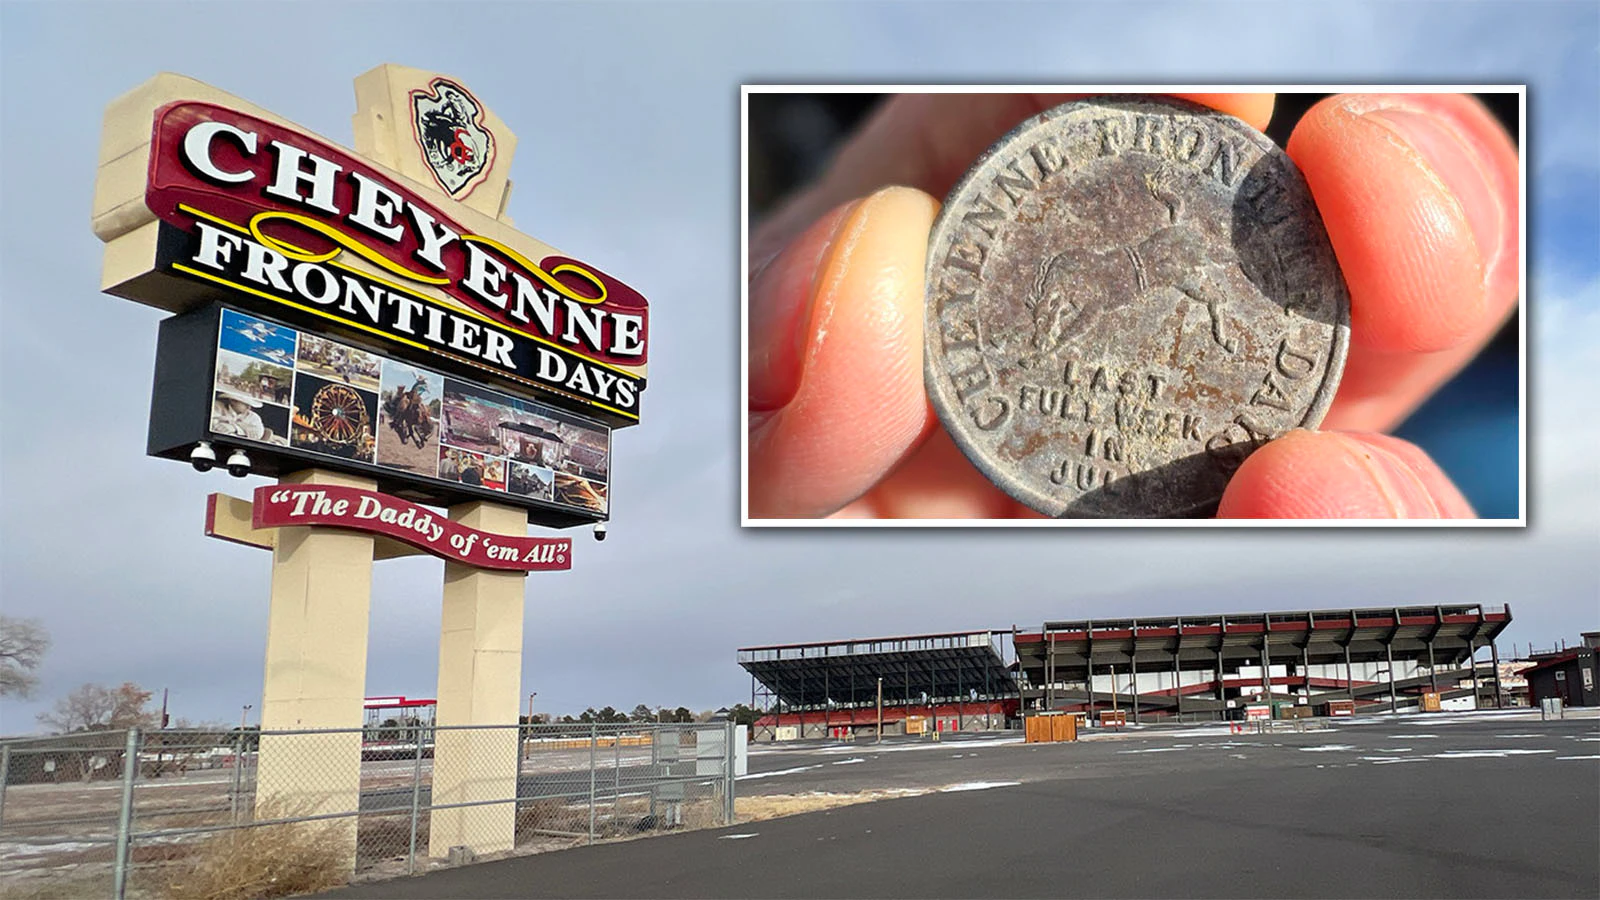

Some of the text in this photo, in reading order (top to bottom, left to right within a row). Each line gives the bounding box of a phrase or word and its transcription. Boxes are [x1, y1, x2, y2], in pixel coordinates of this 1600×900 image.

[182, 120, 645, 356] CHEYENNE
[193, 222, 636, 408] FRONTIER DAYS
[936, 142, 1067, 431] CHEYENNE
[1020, 385, 1203, 442] FULL WEEK
[1063, 360, 1167, 400] LAST
[1085, 428, 1123, 462] IN
[270, 489, 349, 517] “The
[354, 495, 444, 542] Daddy
[450, 533, 478, 556] of
[483, 537, 519, 563] ‘em
